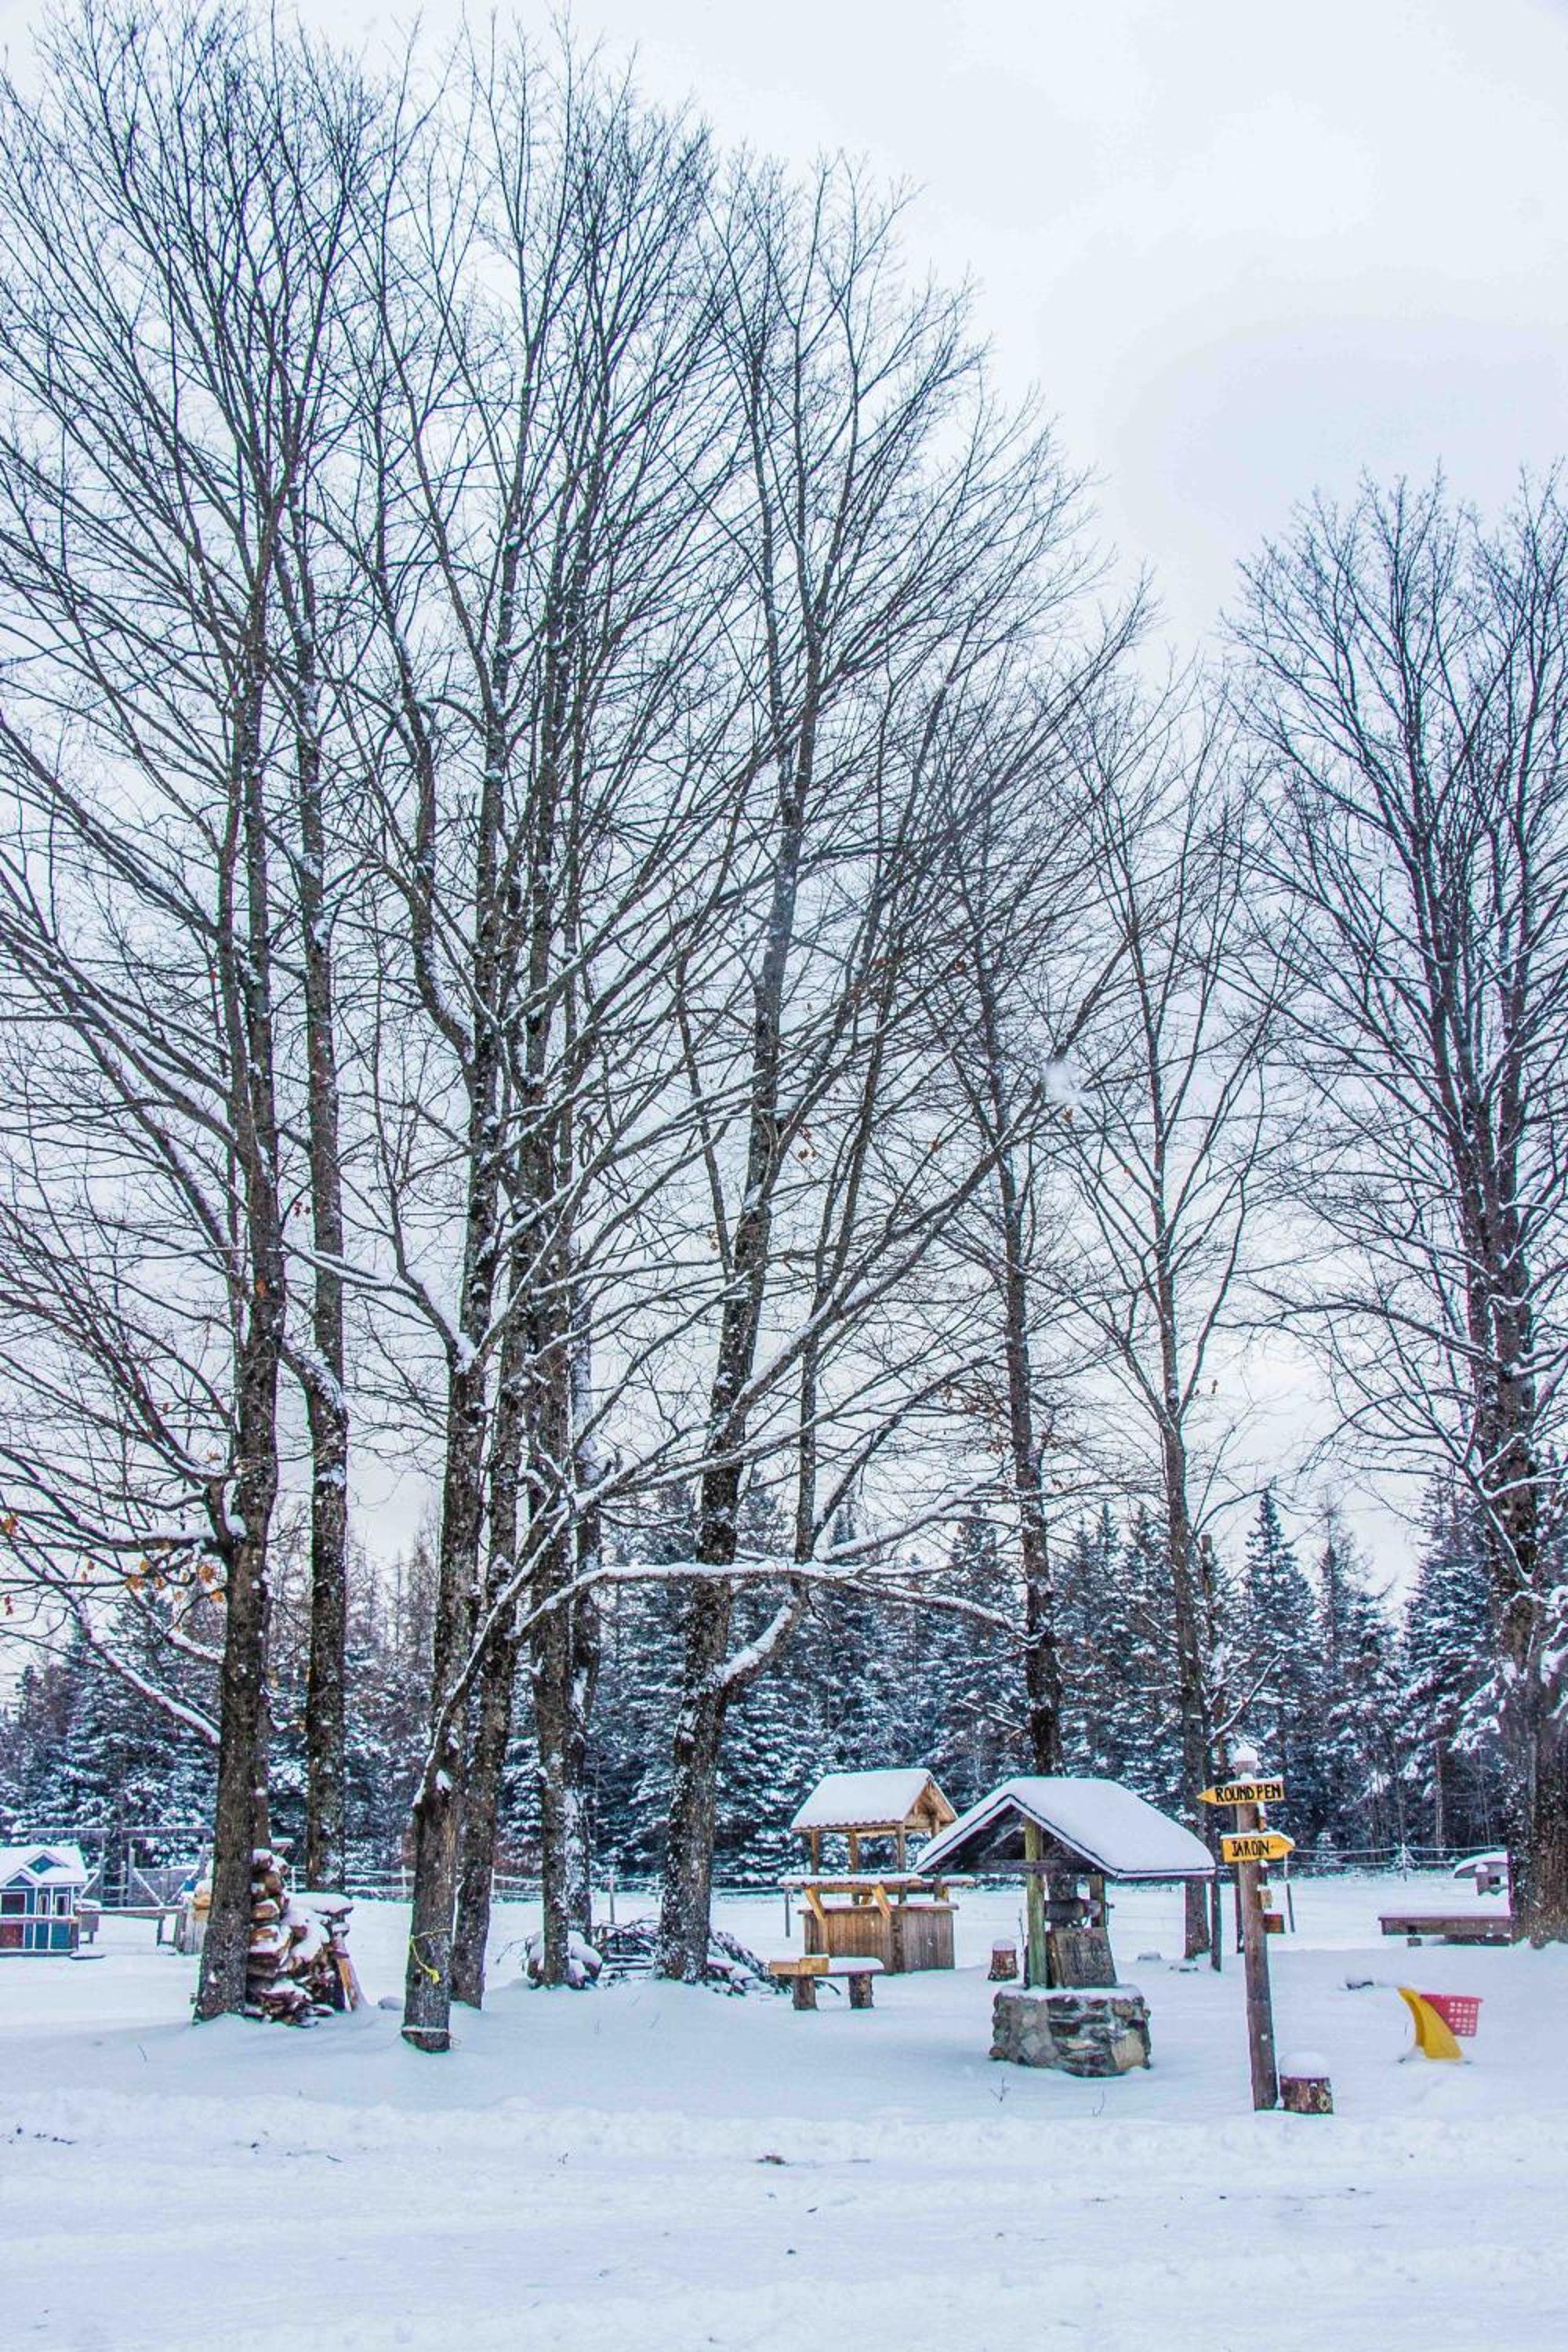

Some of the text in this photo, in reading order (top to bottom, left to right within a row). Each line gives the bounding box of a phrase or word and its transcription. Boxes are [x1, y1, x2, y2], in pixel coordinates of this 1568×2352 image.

[1215, 1784, 1282, 1802] ROUND PEN
[1232, 1840, 1269, 1857] JARDIN
